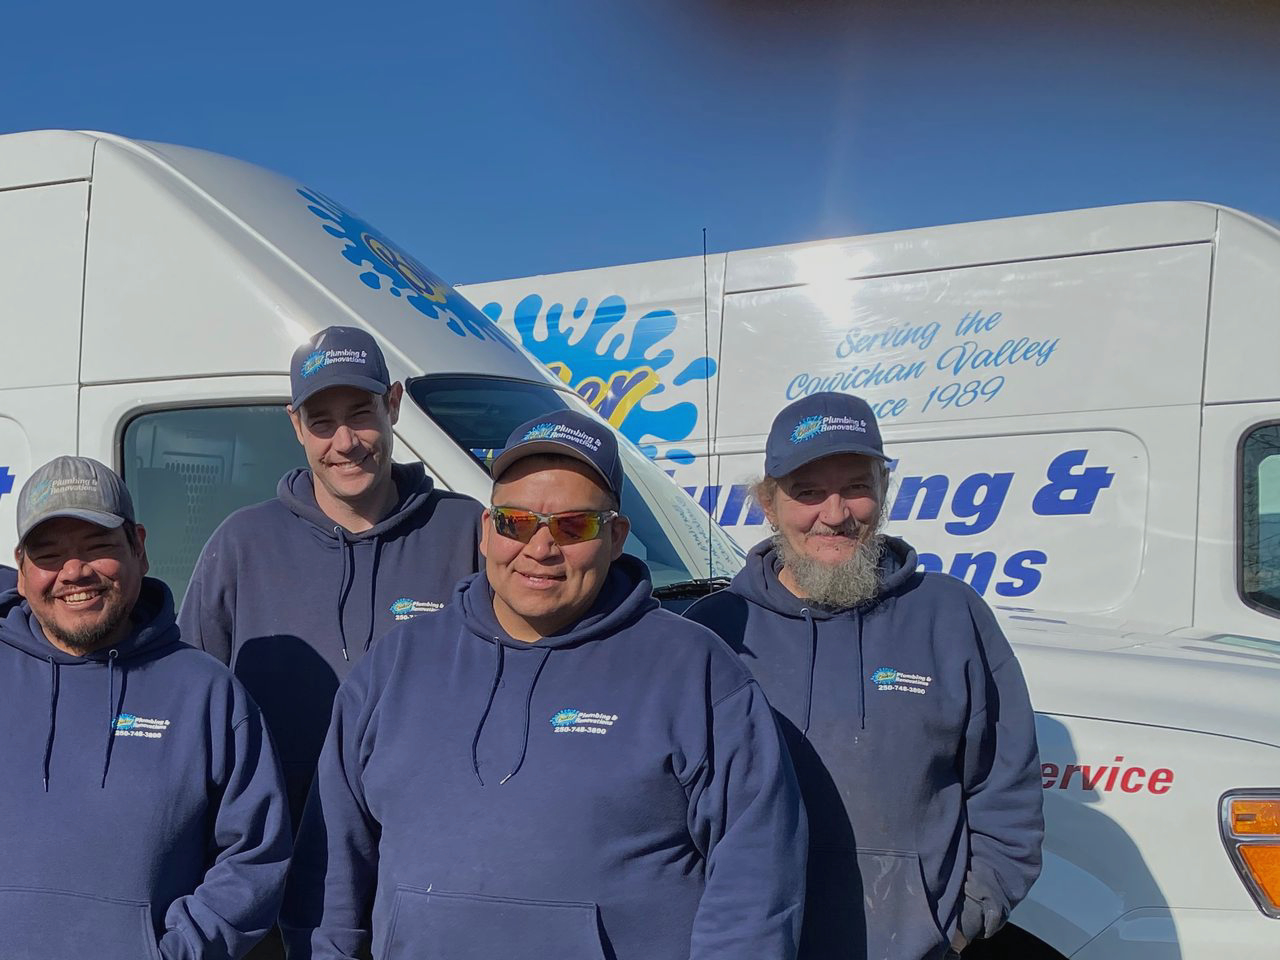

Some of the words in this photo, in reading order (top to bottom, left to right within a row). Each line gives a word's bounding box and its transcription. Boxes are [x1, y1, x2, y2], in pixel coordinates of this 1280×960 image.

[835, 321, 941, 359] Serving
[955, 309, 1003, 337] the
[324, 356, 366, 366] Renovations
[325, 349, 360, 358] Plumbing
[361, 350, 367, 358] &
[785, 359, 926, 401] Cowichan
[936, 336, 1060, 376] Valley
[921, 375, 1005, 413] 1989
[821, 424, 866, 434] Renovations
[823, 416, 859, 427] Plumbing
[549, 431, 598, 452] Renovations
[553, 424, 595, 444] Plumbing
[595, 438, 602, 447] &
[52, 477, 91, 487] Plumbing
[1031, 449, 1115, 516] &
[577, 712, 611, 721] Plumbing
[1039, 756, 1175, 795] ervice
